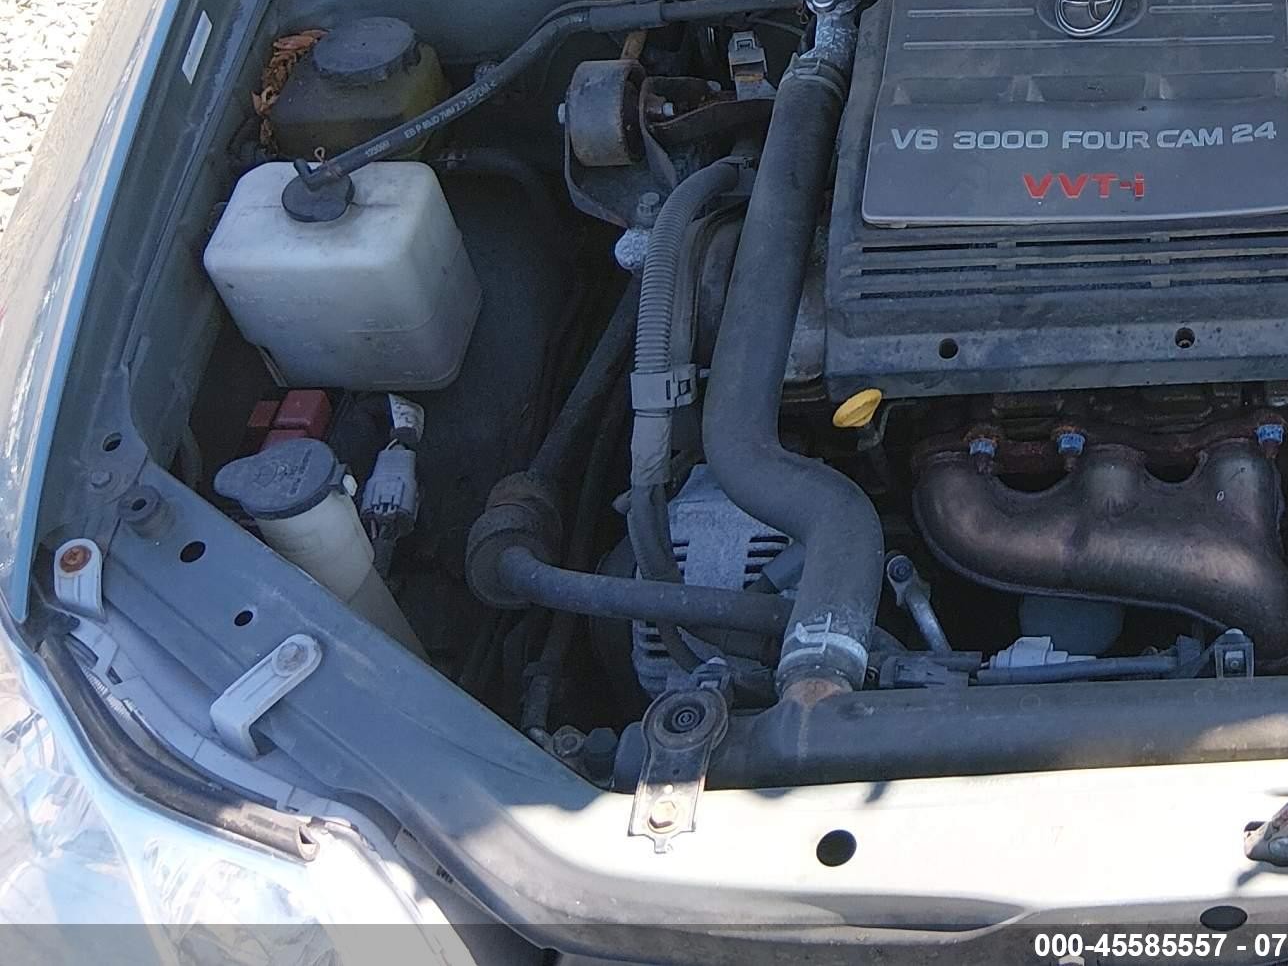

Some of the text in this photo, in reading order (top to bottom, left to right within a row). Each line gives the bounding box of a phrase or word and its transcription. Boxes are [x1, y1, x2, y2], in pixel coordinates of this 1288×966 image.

[891, 121, 1277, 150] V6 3000 FOUR CAM 24
[1023, 172, 1145, 200] VVT-i
